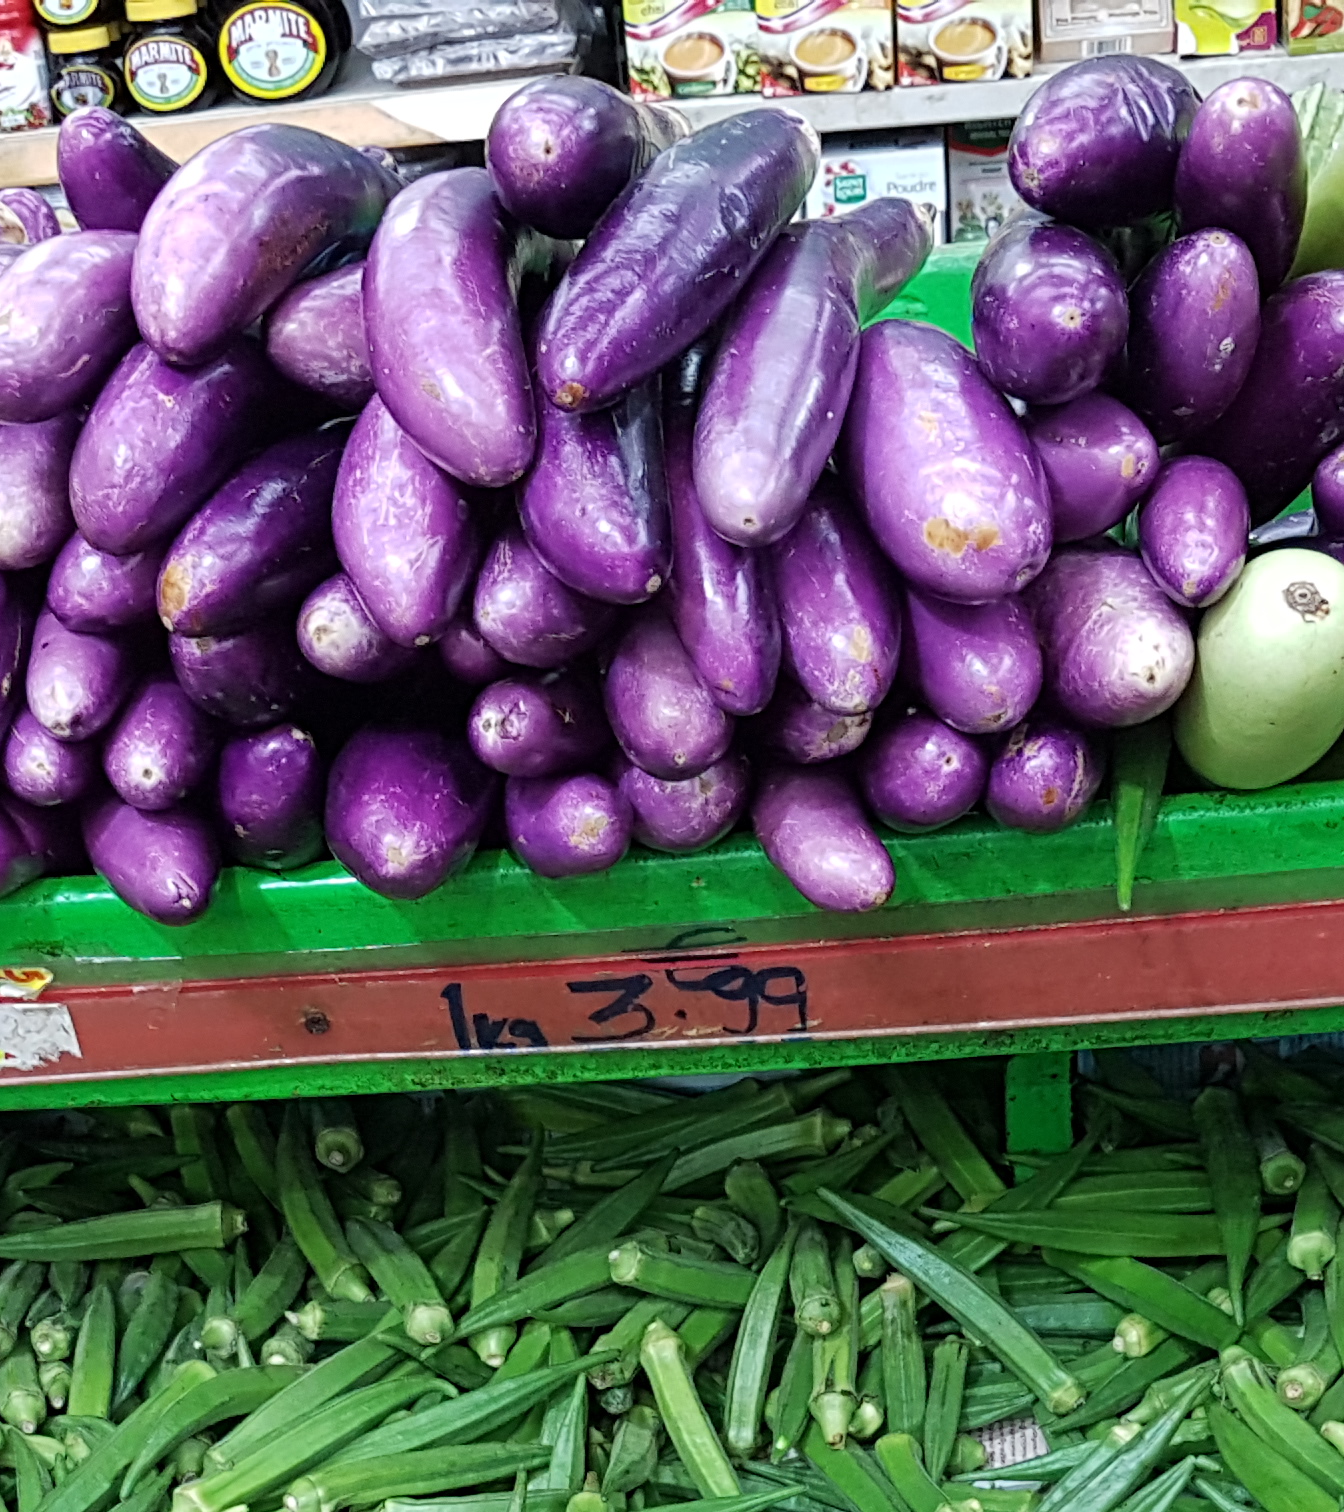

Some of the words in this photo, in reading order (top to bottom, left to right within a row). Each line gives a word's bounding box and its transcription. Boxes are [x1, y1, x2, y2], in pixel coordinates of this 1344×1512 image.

[230, 8, 313, 48] MARMITE
[131, 42, 197, 72] MARMITE
[886, 179, 937, 195] Poudre
